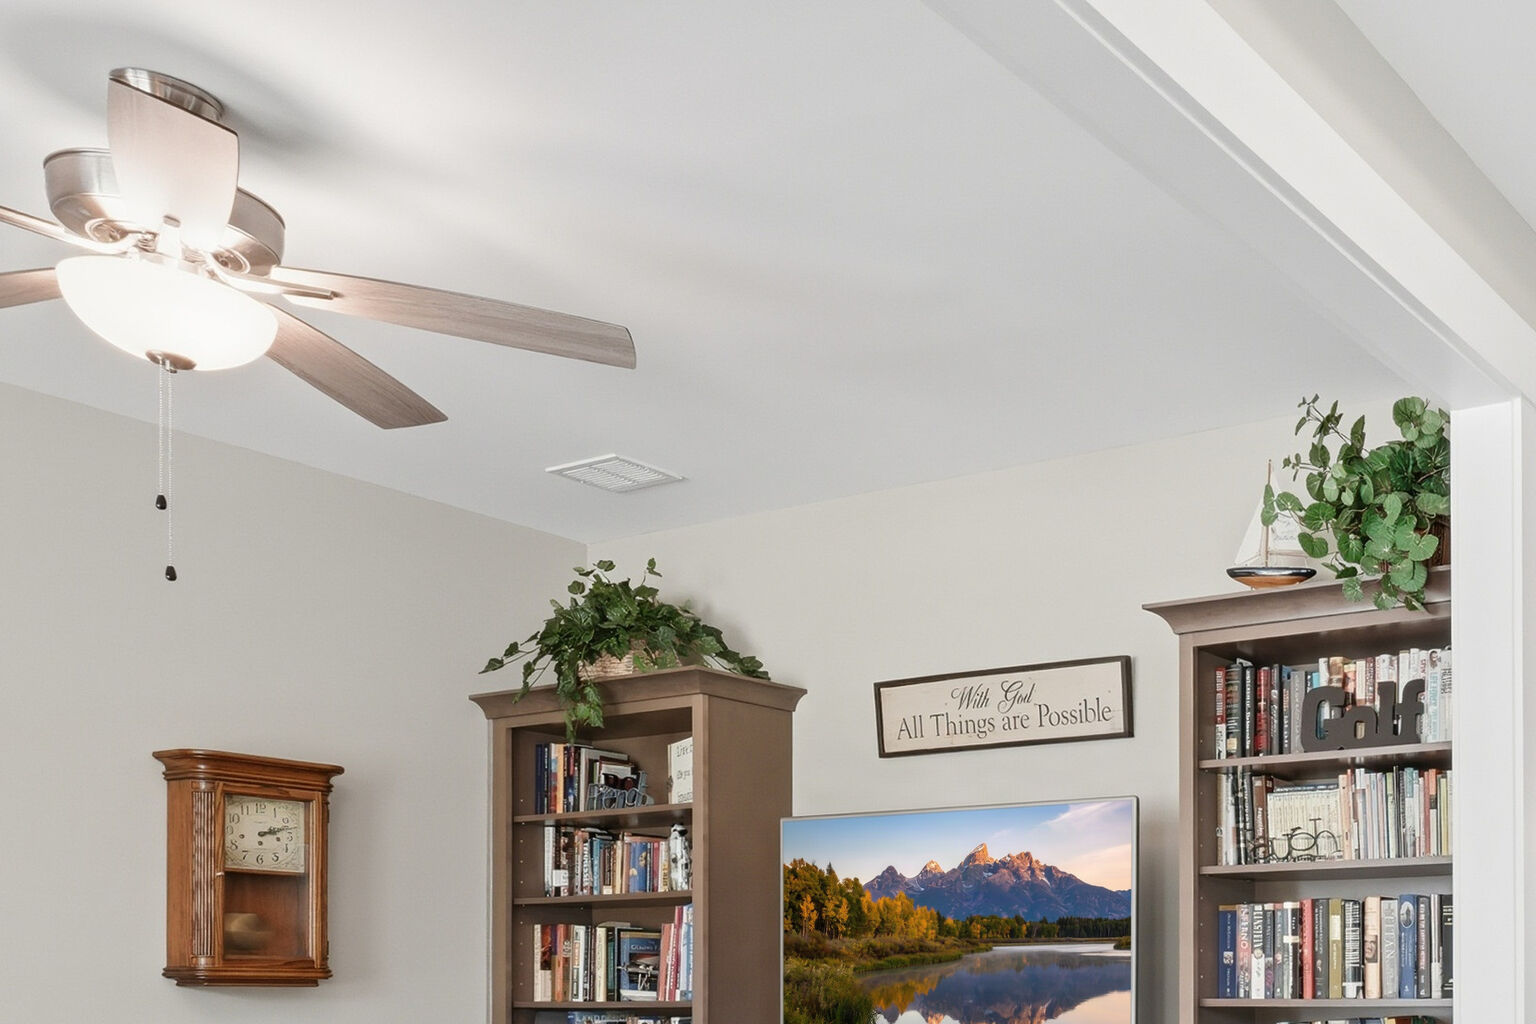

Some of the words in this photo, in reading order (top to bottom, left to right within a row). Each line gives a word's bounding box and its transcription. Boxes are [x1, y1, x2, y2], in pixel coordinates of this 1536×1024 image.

[951, 683, 990, 711] With
[997, 680, 1036, 713] God
[1301, 679, 1426, 751] Golf
[897, 714, 924, 740] All
[930, 712, 996, 739] Things
[1002, 714, 1030, 732] are
[1034, 697, 1113, 728] Possible
